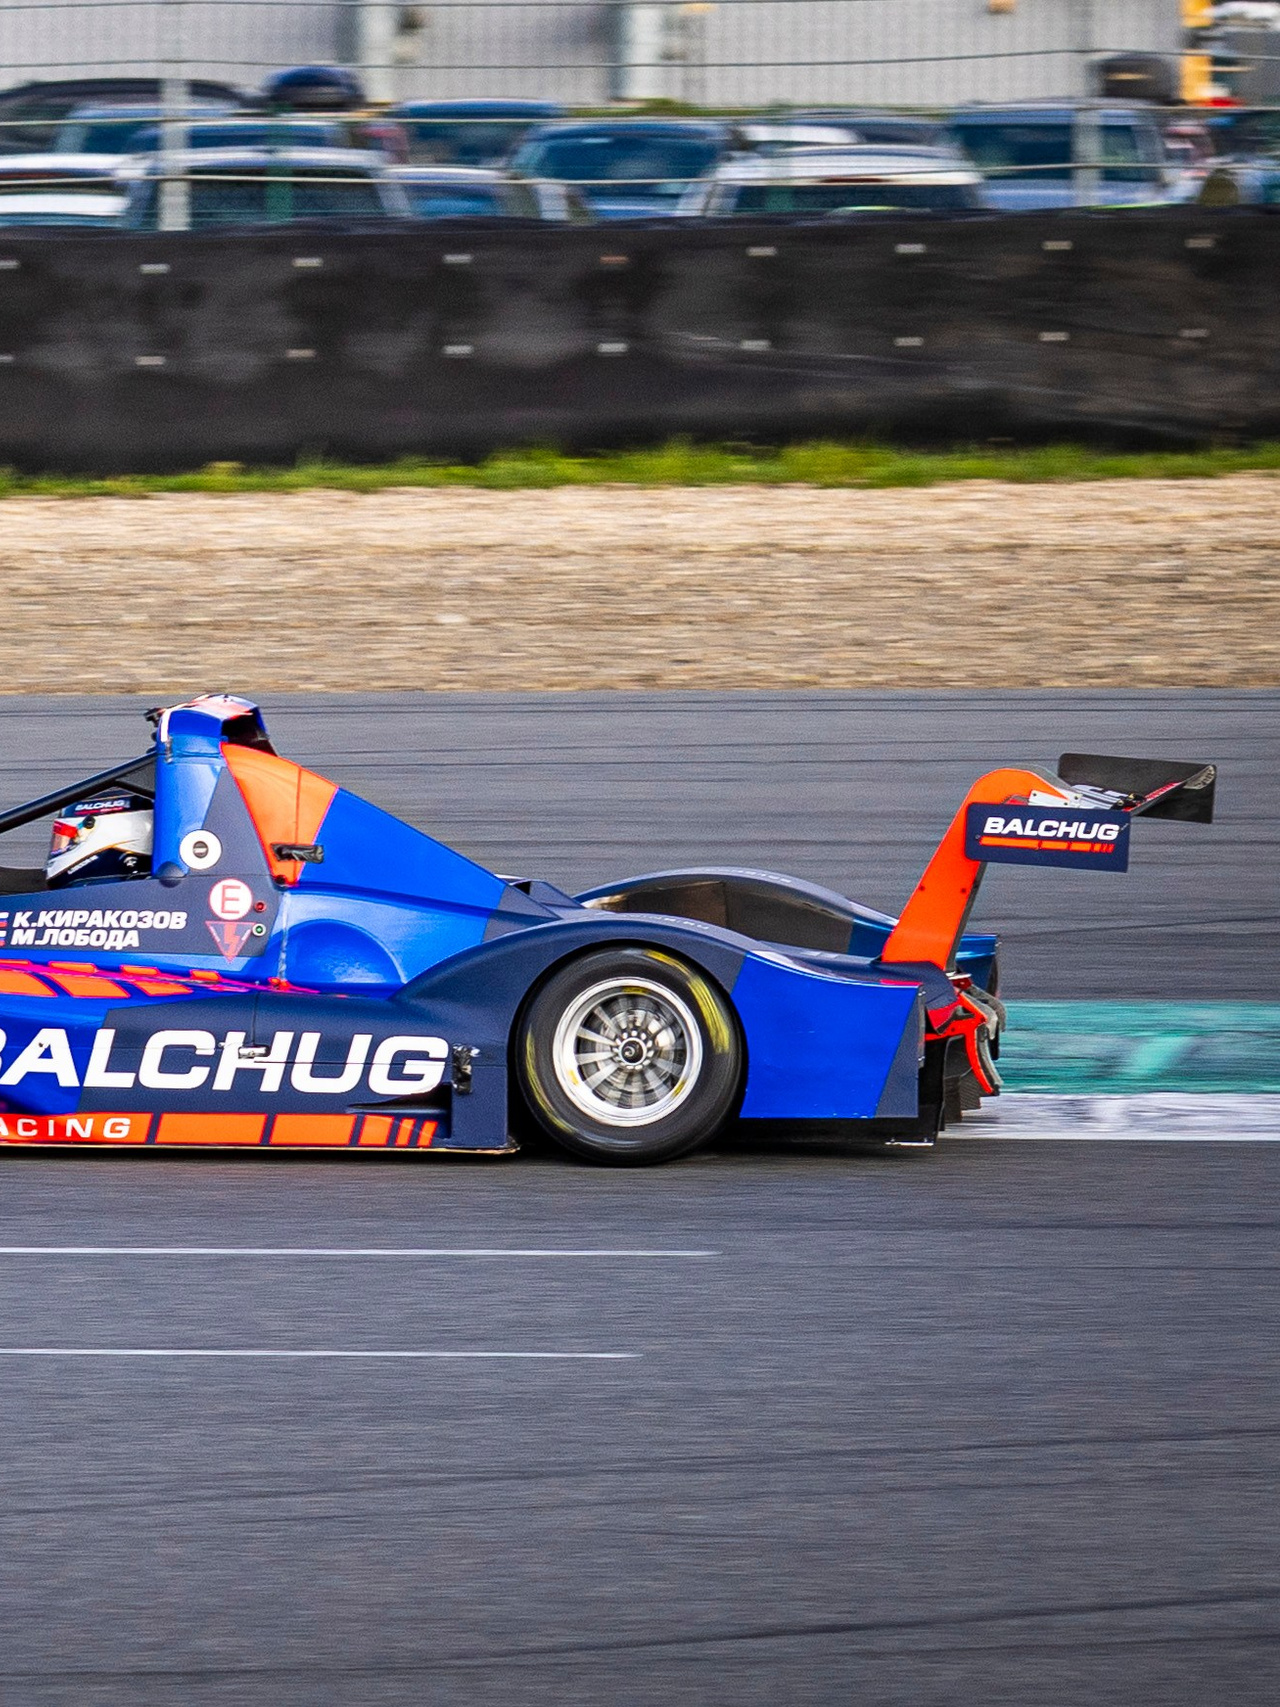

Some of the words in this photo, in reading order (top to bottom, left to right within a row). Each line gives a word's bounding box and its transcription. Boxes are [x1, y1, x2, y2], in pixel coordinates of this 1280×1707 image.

[984, 816, 1119, 841] BALCHUG
[12, 910, 188, 930] К.КИРАКОЗОВ
[10, 928, 140, 950] М.ЛОБОДА
